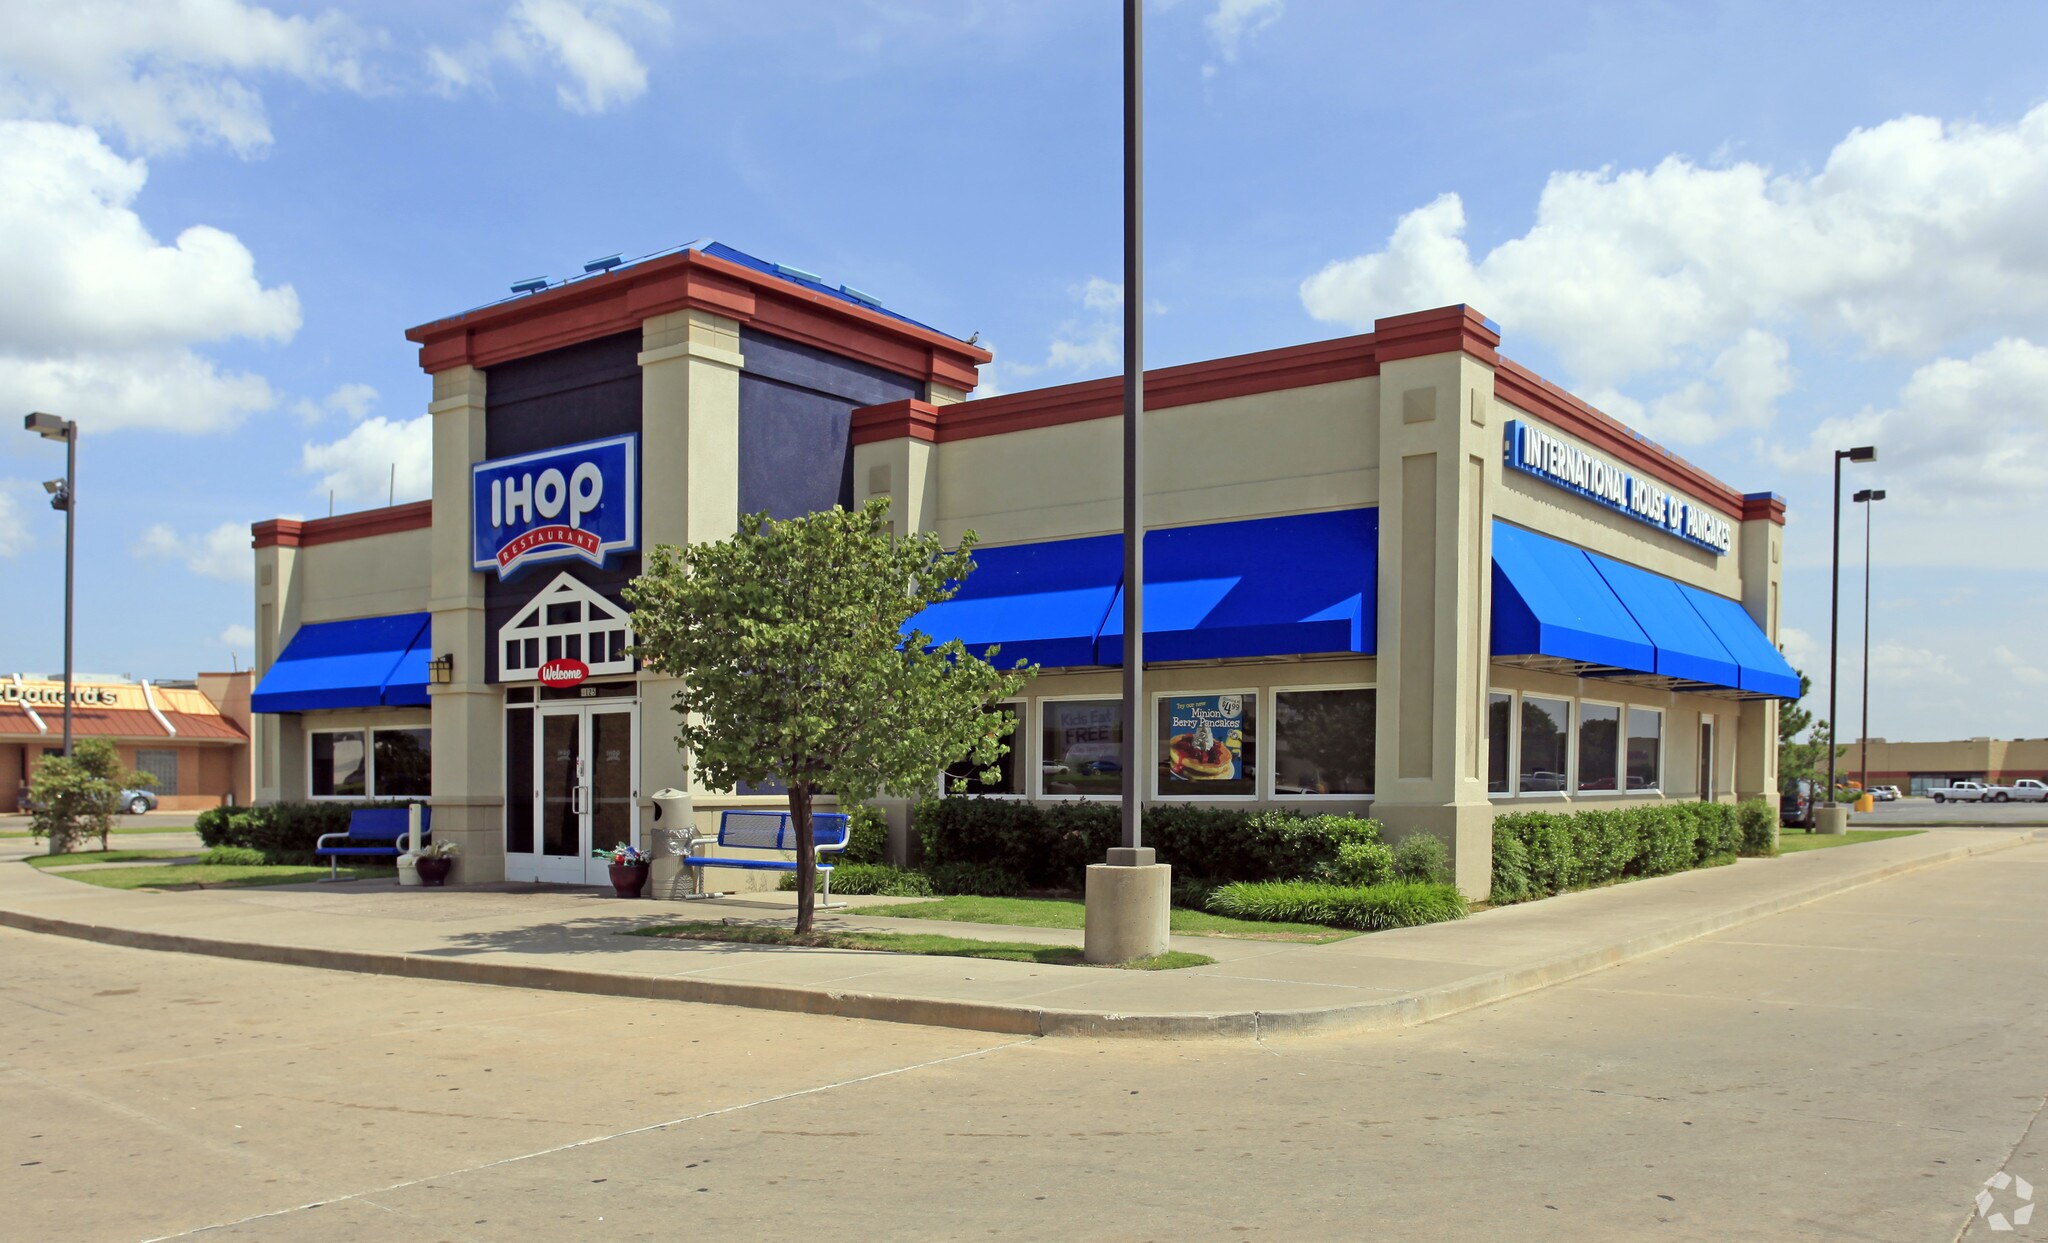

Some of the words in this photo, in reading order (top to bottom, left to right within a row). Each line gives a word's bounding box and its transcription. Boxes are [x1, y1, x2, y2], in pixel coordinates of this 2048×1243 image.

[491, 461, 603, 530] IHOP
[1523, 424, 1628, 506] INTERNATIONAL
[1630, 476, 1666, 523] HOUSE
[1669, 495, 1684, 529] OF
[1686, 503, 1731, 552] PANCAKES
[503, 530, 595, 561] RESTAURANT
[542, 664, 582, 681] Welcome
[0, 684, 116, 705] Donald's
[1061, 712, 1088, 726] Kids
[1089, 709, 1112, 723] Eat
[1191, 707, 1222, 718] Minion
[1172, 717, 1198, 729] Berry
[1199, 717, 1240, 728] Pancakes
[1065, 725, 1109, 744] FREE
